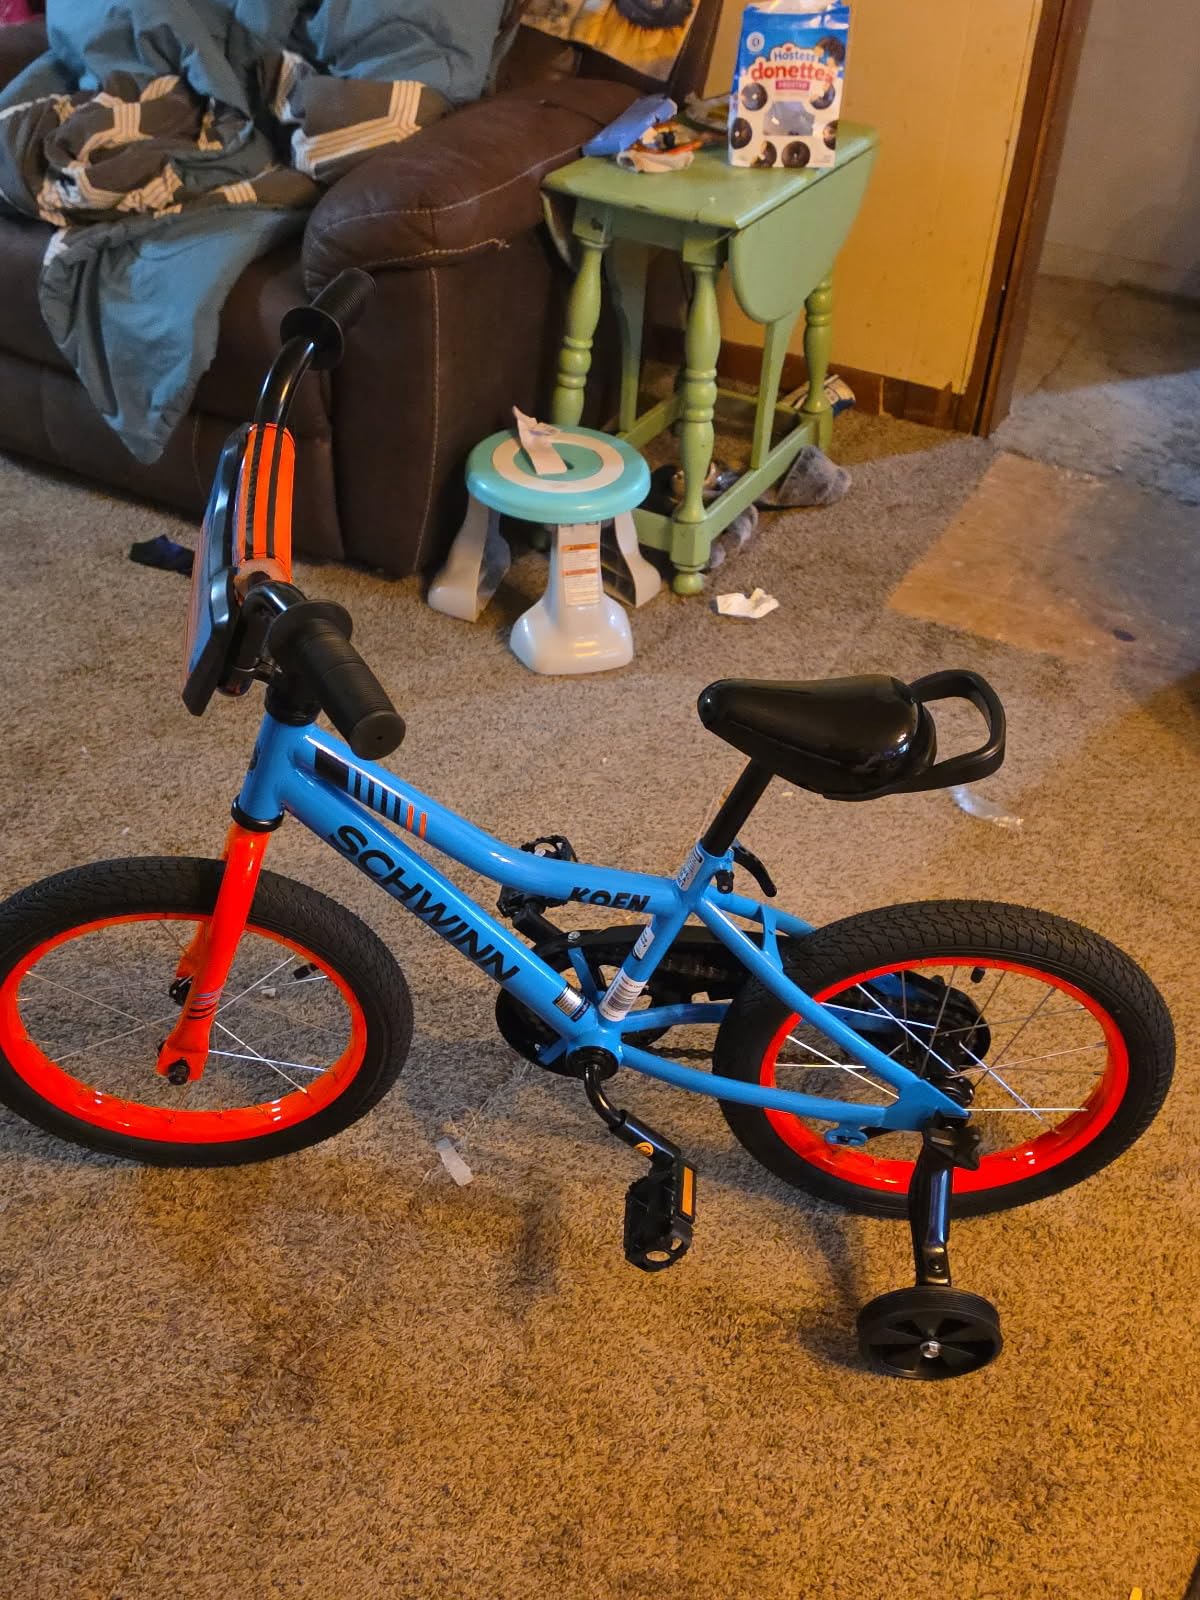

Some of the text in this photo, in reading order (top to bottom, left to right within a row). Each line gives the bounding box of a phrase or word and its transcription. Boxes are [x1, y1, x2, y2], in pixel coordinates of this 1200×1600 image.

[751, 62, 833, 83] donettes
[330, 825, 521, 982] SCHWINN
[568, 886, 651, 912] KOEN
